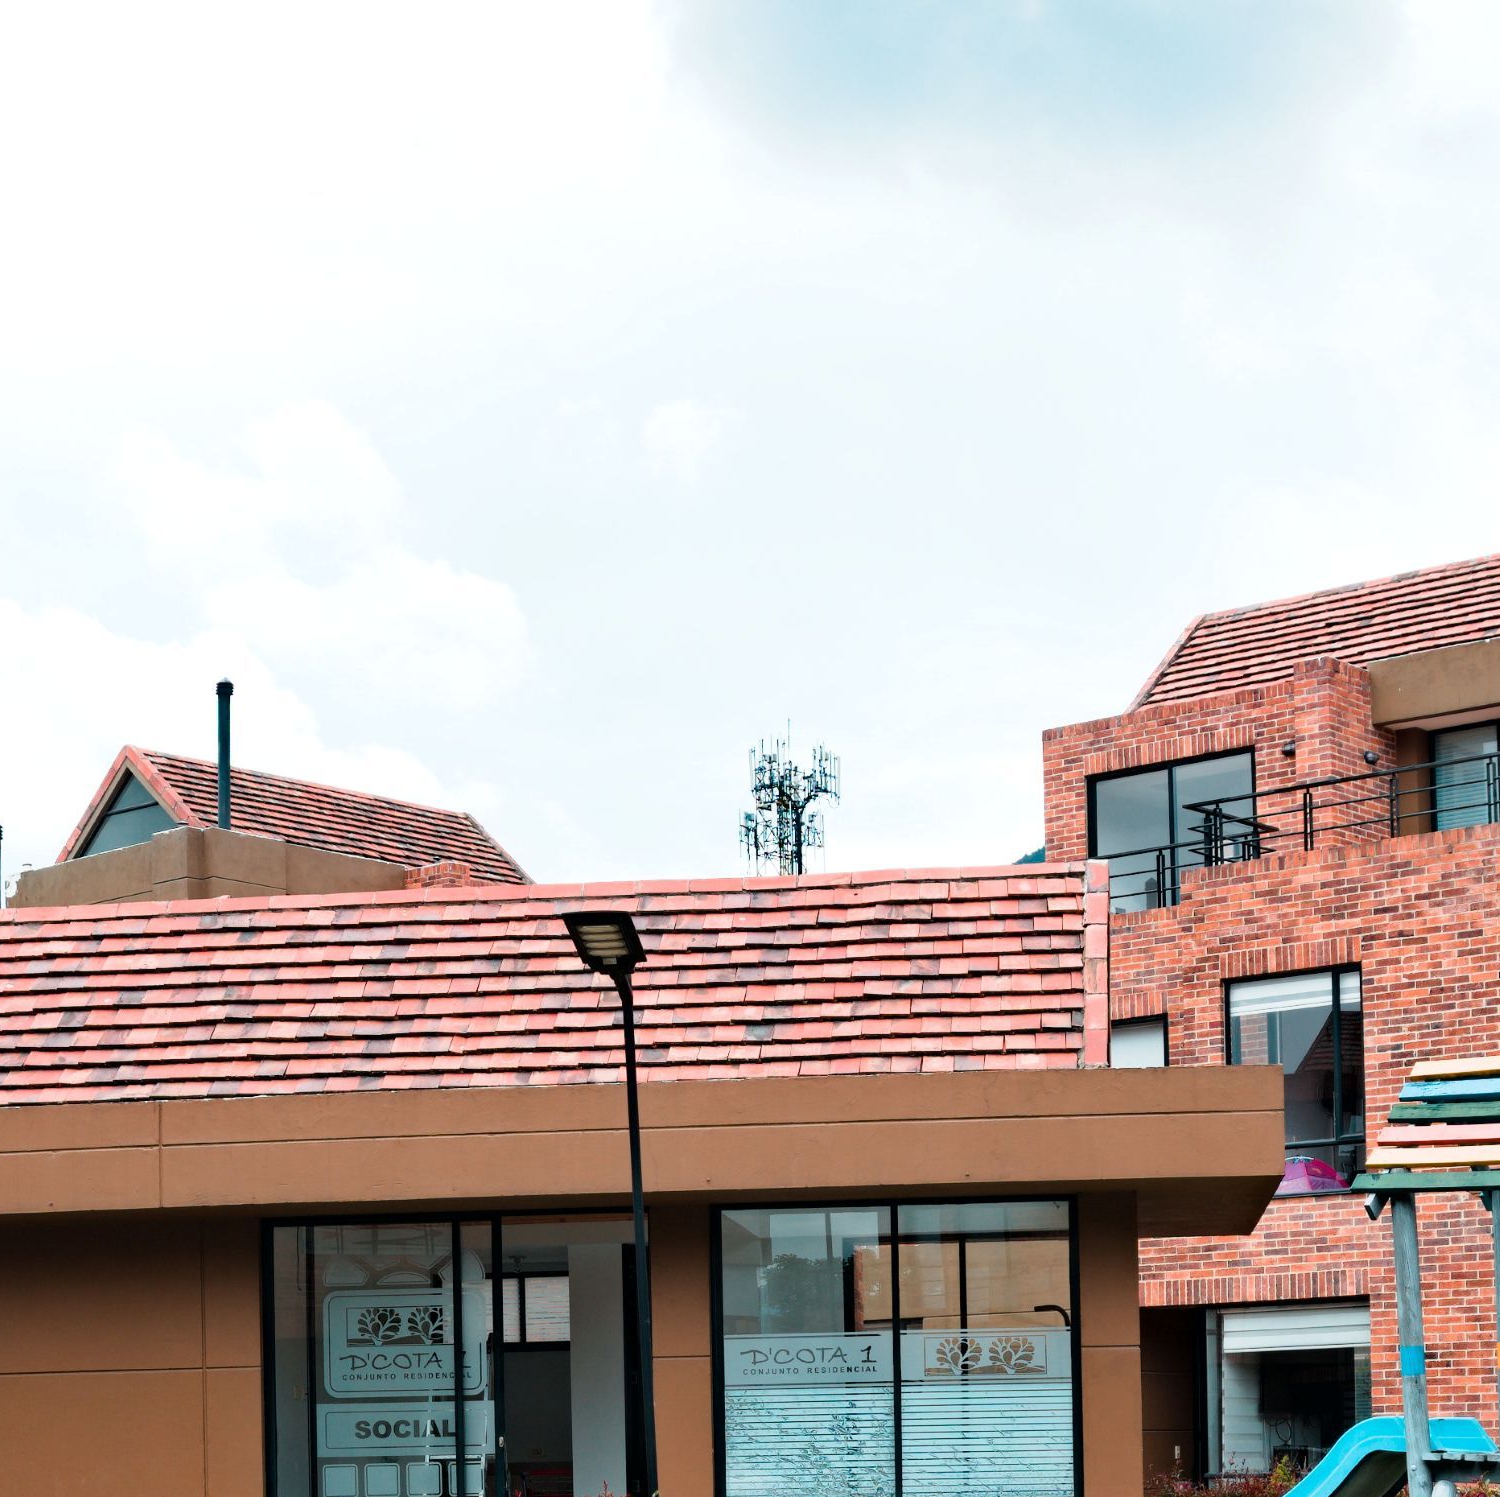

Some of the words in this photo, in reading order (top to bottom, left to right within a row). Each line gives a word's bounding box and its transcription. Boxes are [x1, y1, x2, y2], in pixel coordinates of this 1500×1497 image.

[740, 1346, 848, 1366] D'COTA
[860, 1345, 877, 1363] 1
[342, 1373, 397, 1381] CONJUNTO
[403, 1371, 472, 1380] RESIDENCL
[742, 1367, 799, 1376] CONJUNTO
[807, 1365, 878, 1374] RESIDENCIAL
[354, 1419, 456, 1440] SOCIAL
